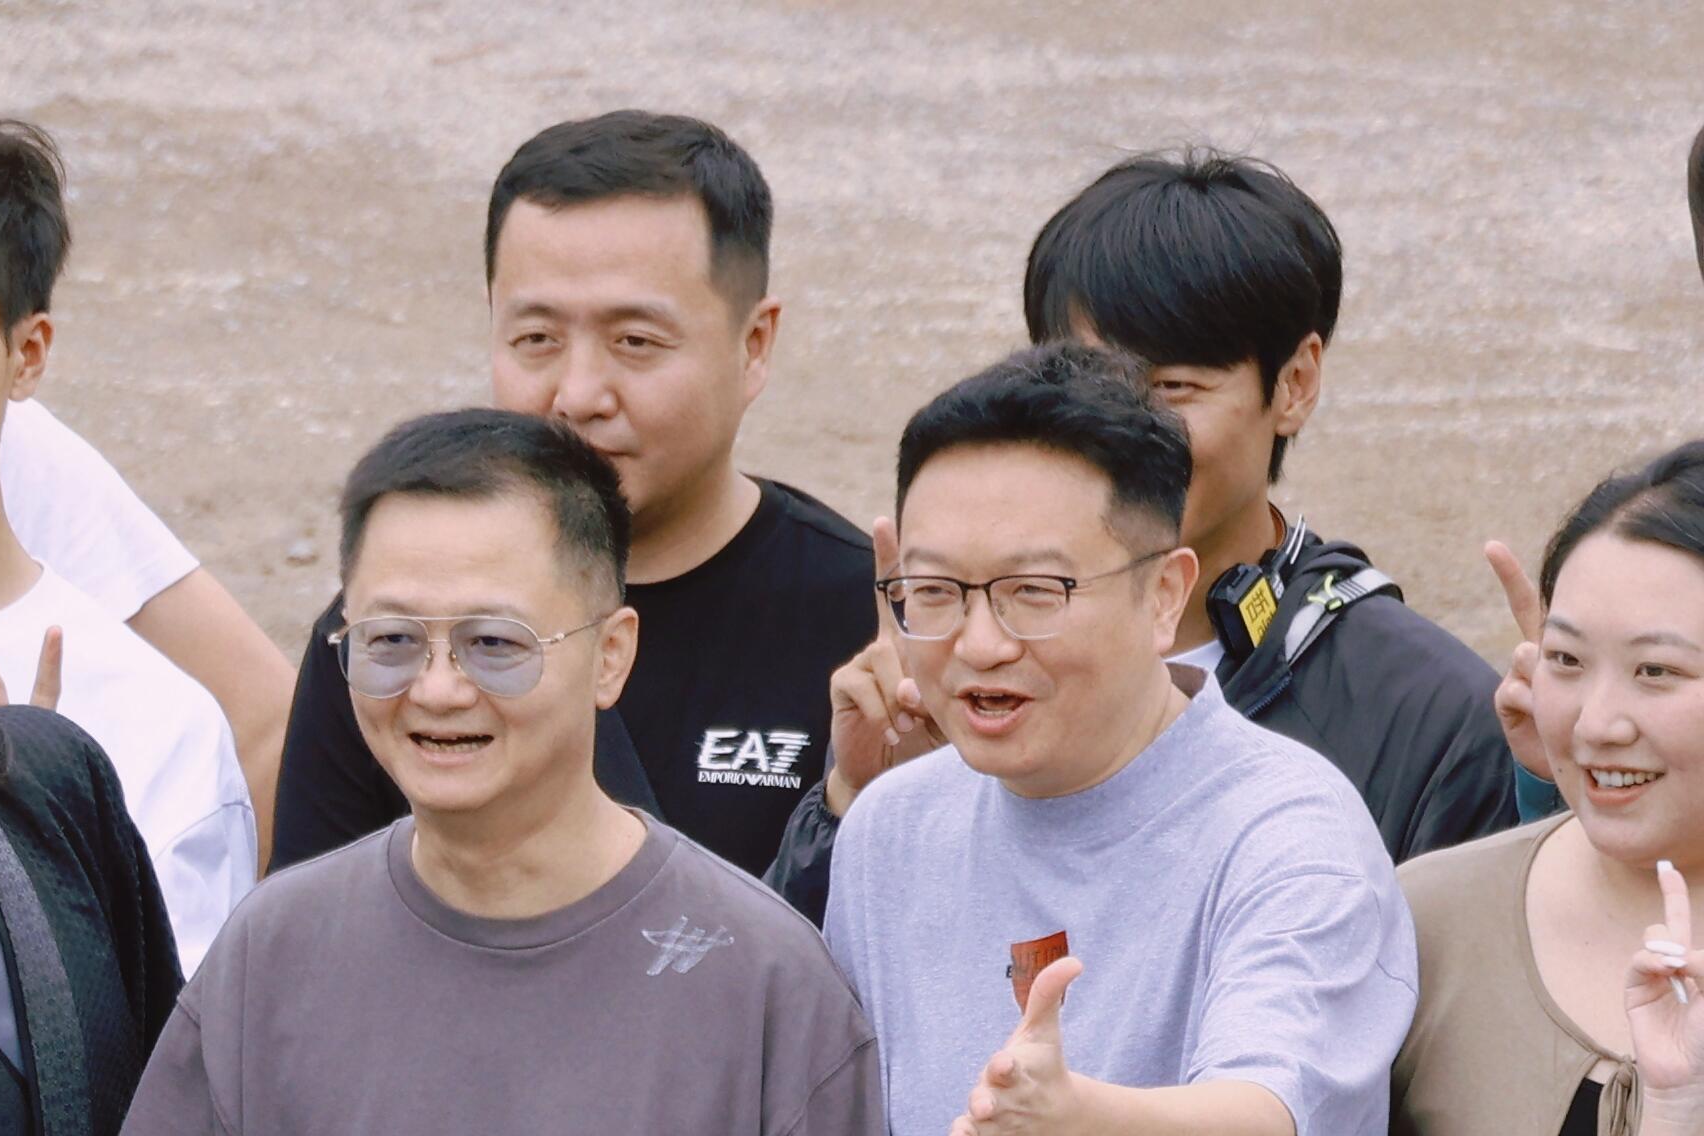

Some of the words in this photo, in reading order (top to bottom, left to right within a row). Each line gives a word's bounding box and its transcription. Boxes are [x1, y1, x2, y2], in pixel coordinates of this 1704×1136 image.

[697, 729, 811, 775] EA7
[698, 770, 746, 786] EMPORIO
[759, 774, 802, 789] ARMANI
